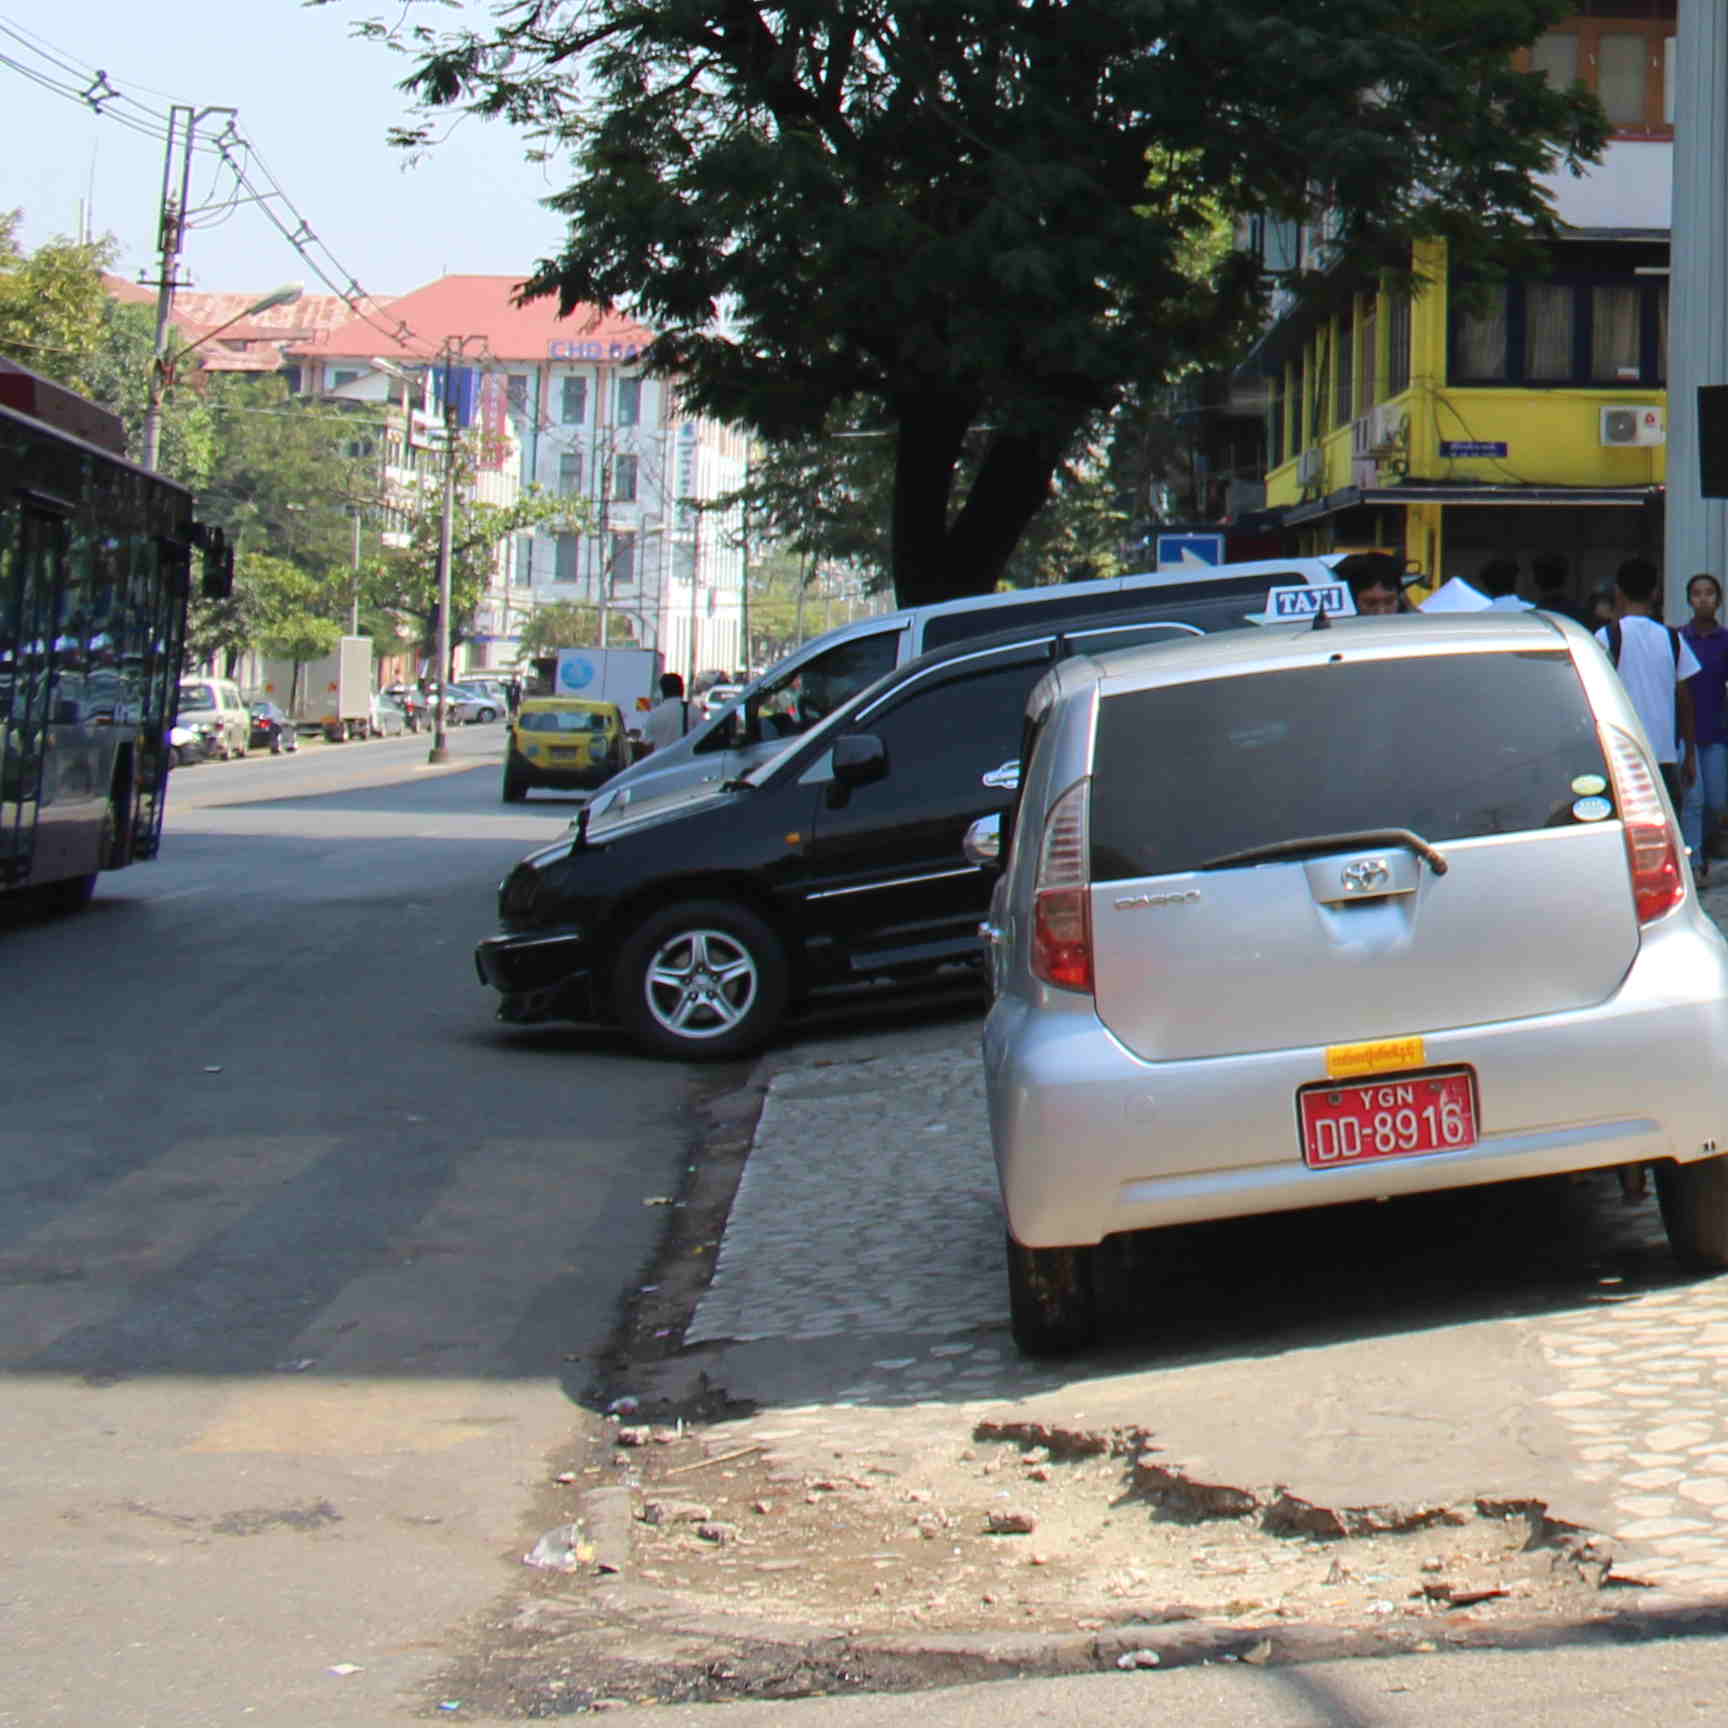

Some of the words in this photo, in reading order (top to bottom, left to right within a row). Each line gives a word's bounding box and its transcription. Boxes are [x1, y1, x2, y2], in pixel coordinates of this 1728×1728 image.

[1278, 589, 1342, 614] TAXI
[1360, 1085, 1414, 1111] YGN
[1315, 1103, 1464, 1160] DD-8916
